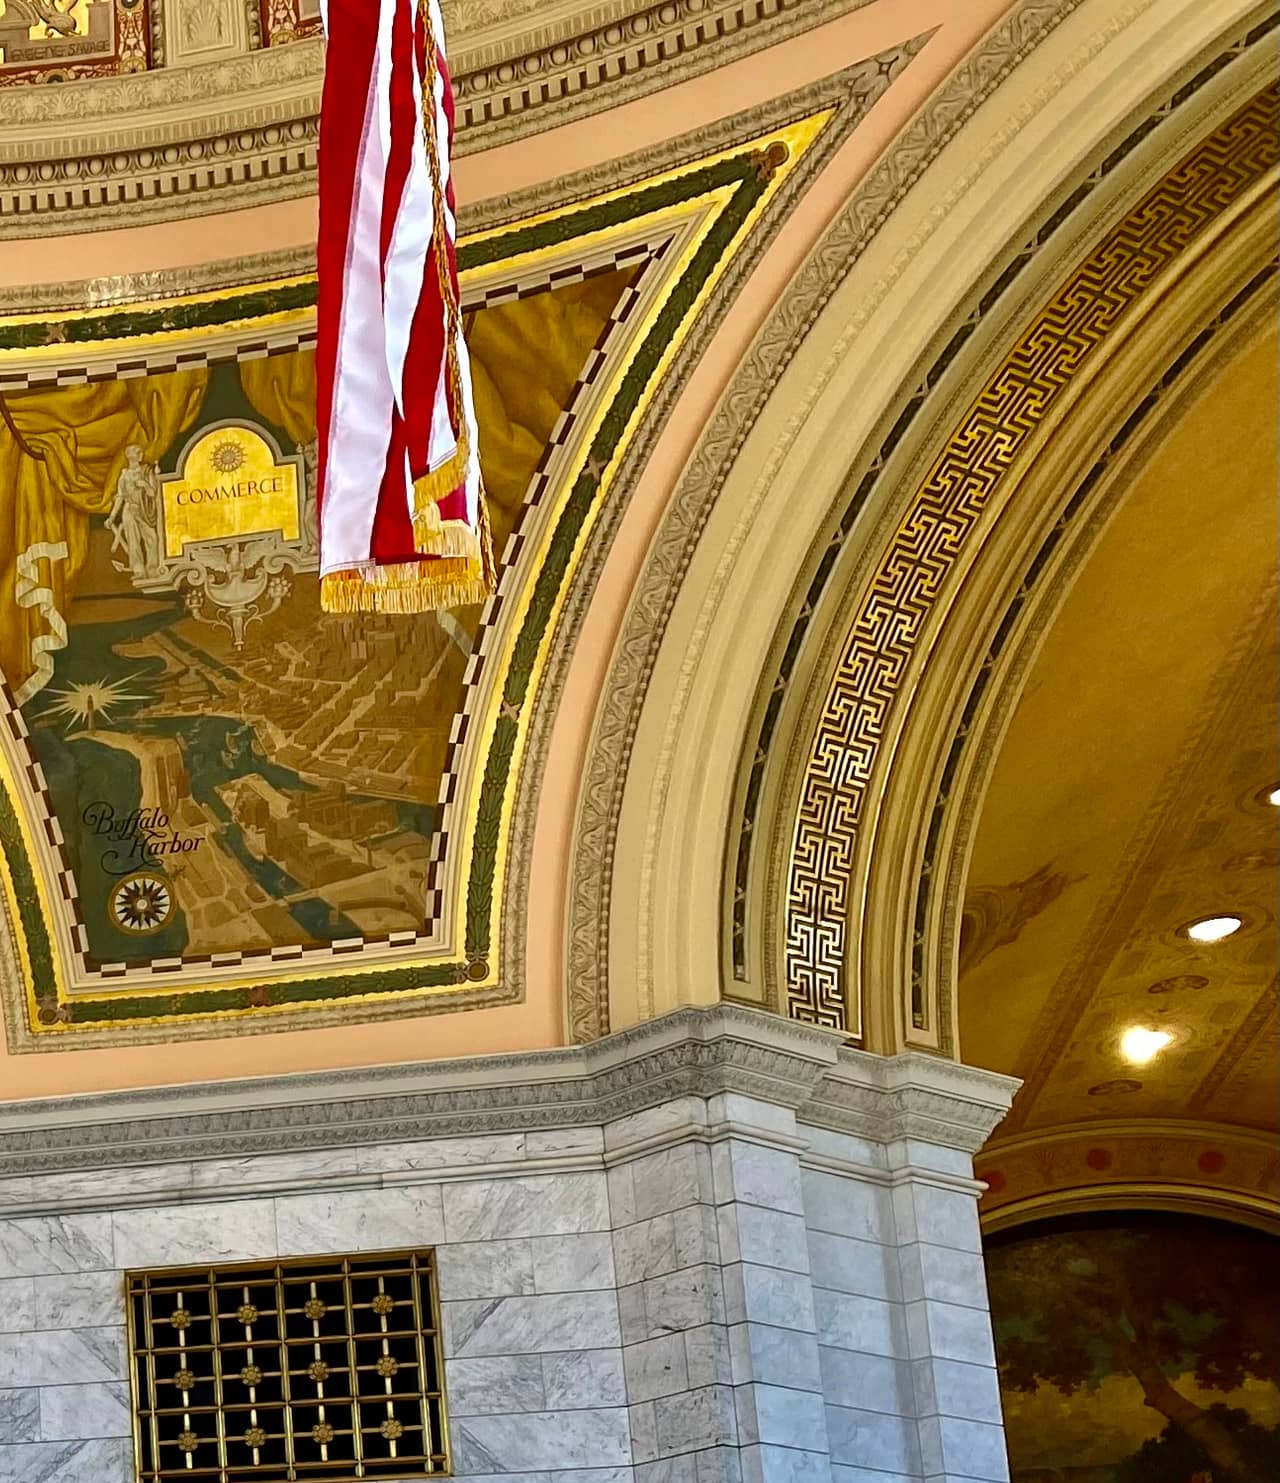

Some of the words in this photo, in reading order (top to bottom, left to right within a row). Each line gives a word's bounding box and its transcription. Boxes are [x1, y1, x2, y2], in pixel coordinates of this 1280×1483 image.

[67, 39, 111, 56] SAVAGE
[177, 477, 283, 506] COMMERCE
[82, 801, 170, 841] Buffalo
[101, 831, 206, 875] Harbor
